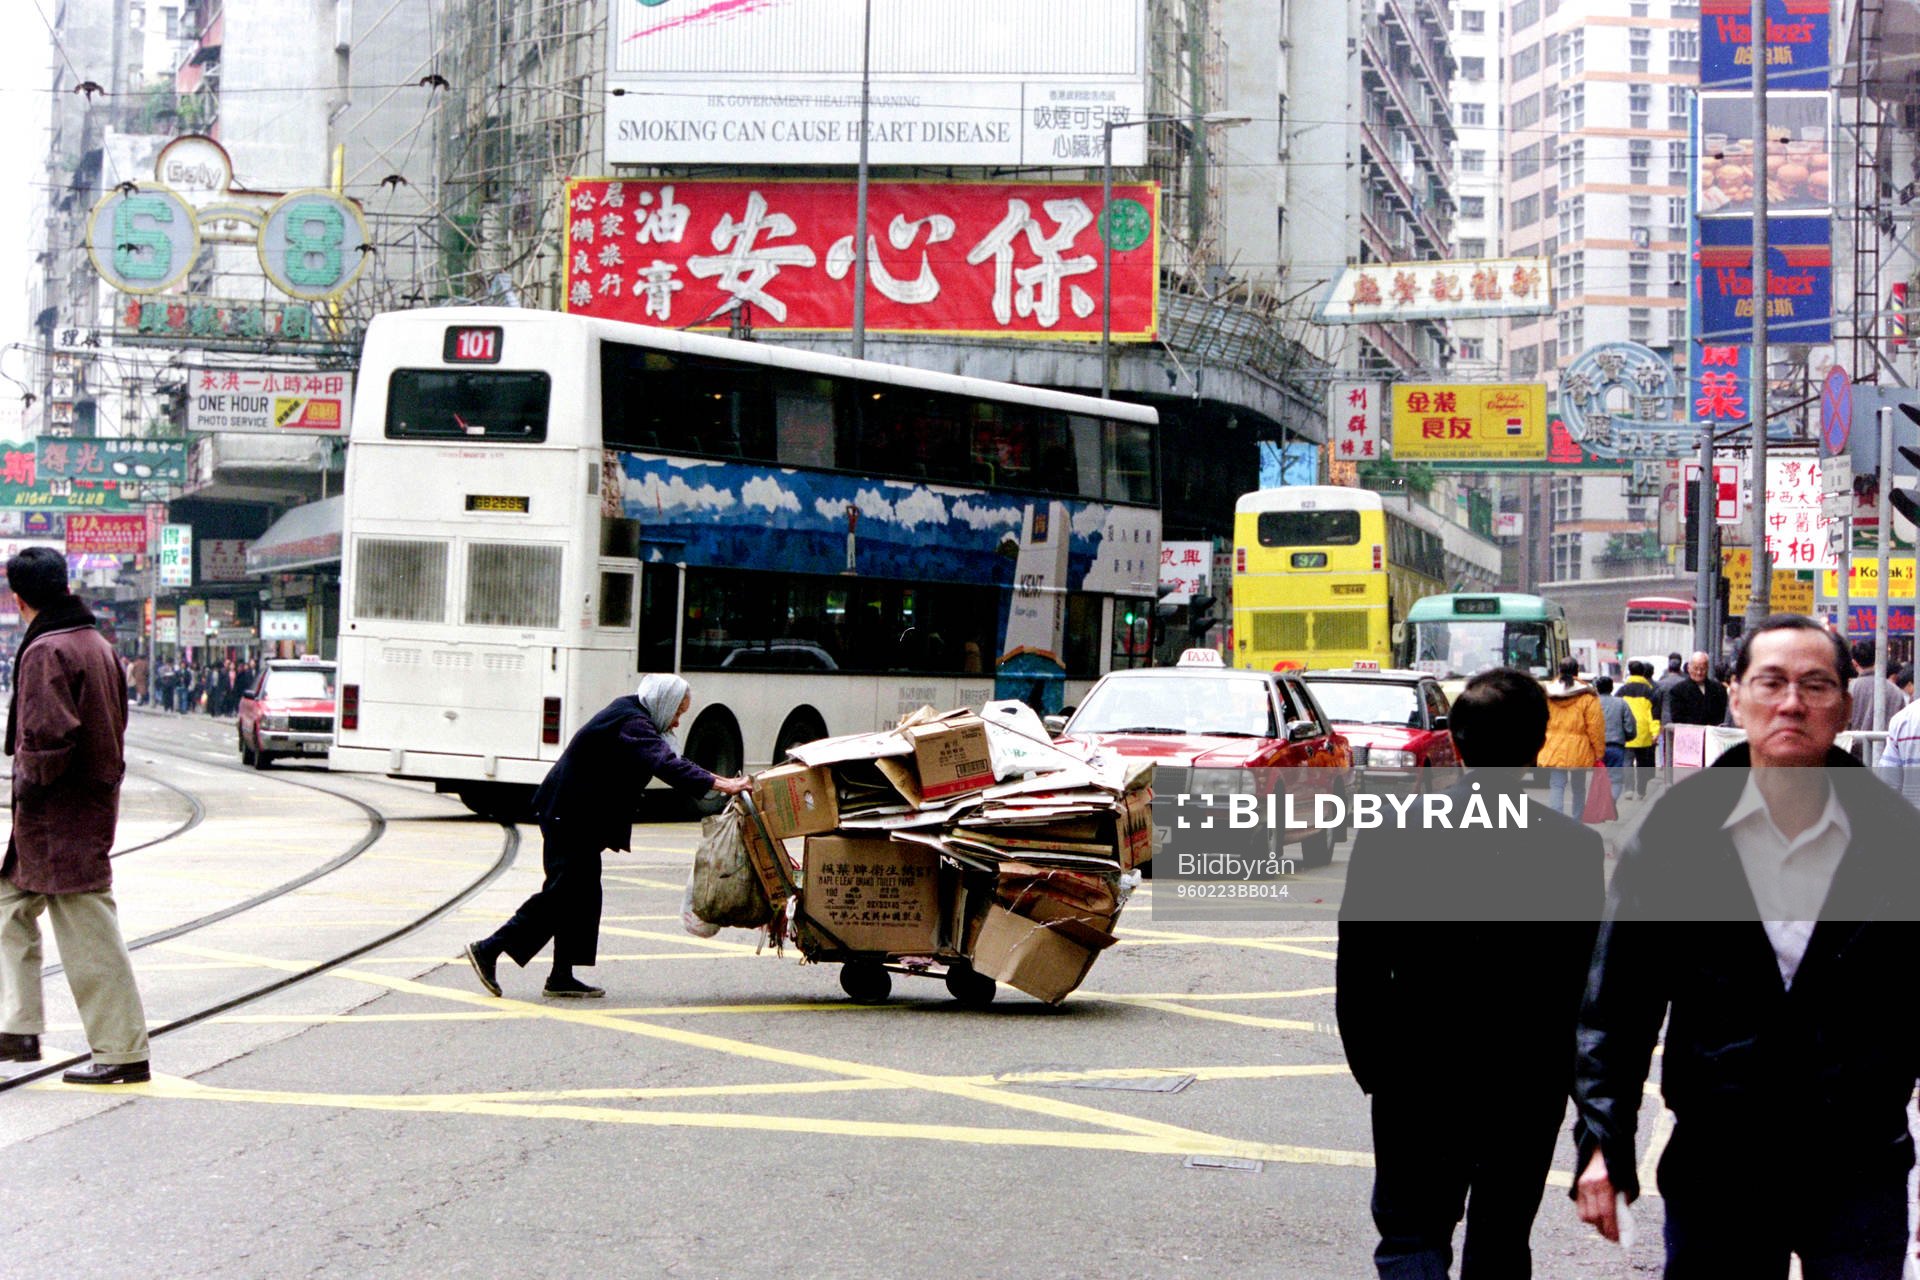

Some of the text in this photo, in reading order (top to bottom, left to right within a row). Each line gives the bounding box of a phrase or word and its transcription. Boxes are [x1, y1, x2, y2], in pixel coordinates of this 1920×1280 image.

[1716, 16, 1815, 44] Haee's
[707, 95, 725, 107] HK
[728, 95, 811, 108] GOVERNMENT
[815, 95, 862, 108] HEALTH
[618, 120, 717, 142] SMOKING
[723, 120, 766, 142] CAN
[771, 120, 841, 143] CAUSE
[922, 121, 1011, 144] DISEASE
[113, 197, 345, 287] 6 8
[1716, 267, 1816, 296] Haee's
[459, 331, 494, 358] 101
[199, 395, 225, 412] ONE
[231, 396, 269, 413] HOUR
[197, 415, 268, 428] PHOTO SERVICE
[67, 492, 105, 505] CLUB
[1860, 566, 1903, 578] Koak
[1186, 647, 1217, 662] TAXI
[1354, 661, 1378, 671] TAXI
